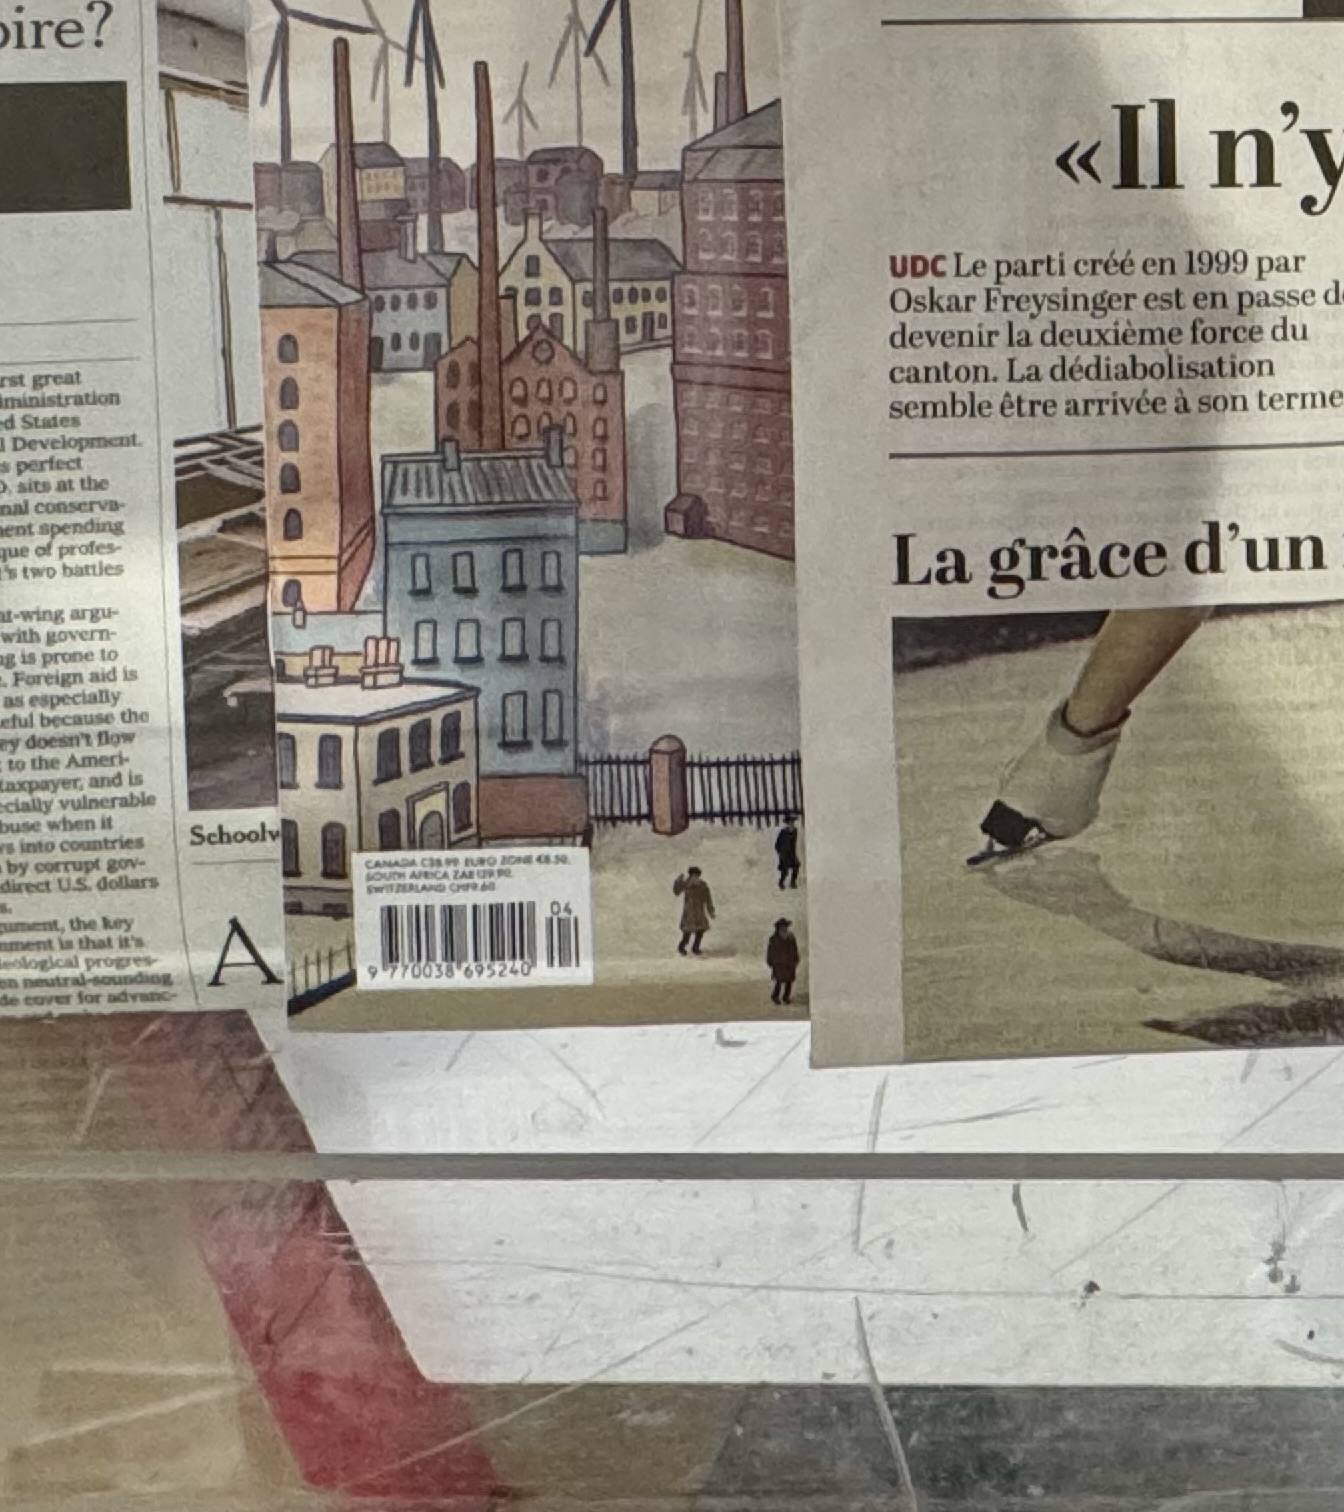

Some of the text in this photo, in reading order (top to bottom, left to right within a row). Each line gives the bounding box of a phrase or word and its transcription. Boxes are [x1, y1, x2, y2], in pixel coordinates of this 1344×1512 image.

[889, 249, 1249, 286] UDC parti créé 1999
[889, 286, 1138, 320] Oskar Freysinger
[1040, 319, 1183, 347] deuxième
[889, 348, 1275, 384] canton. dédiabolisation
[889, 389, 1344, 419] semble terme
[893, 533, 973, 586] La
[987, 526, 1167, 600] grâce
[1185, 521, 1328, 575] d'un
[550, 900, 573, 916] 04
